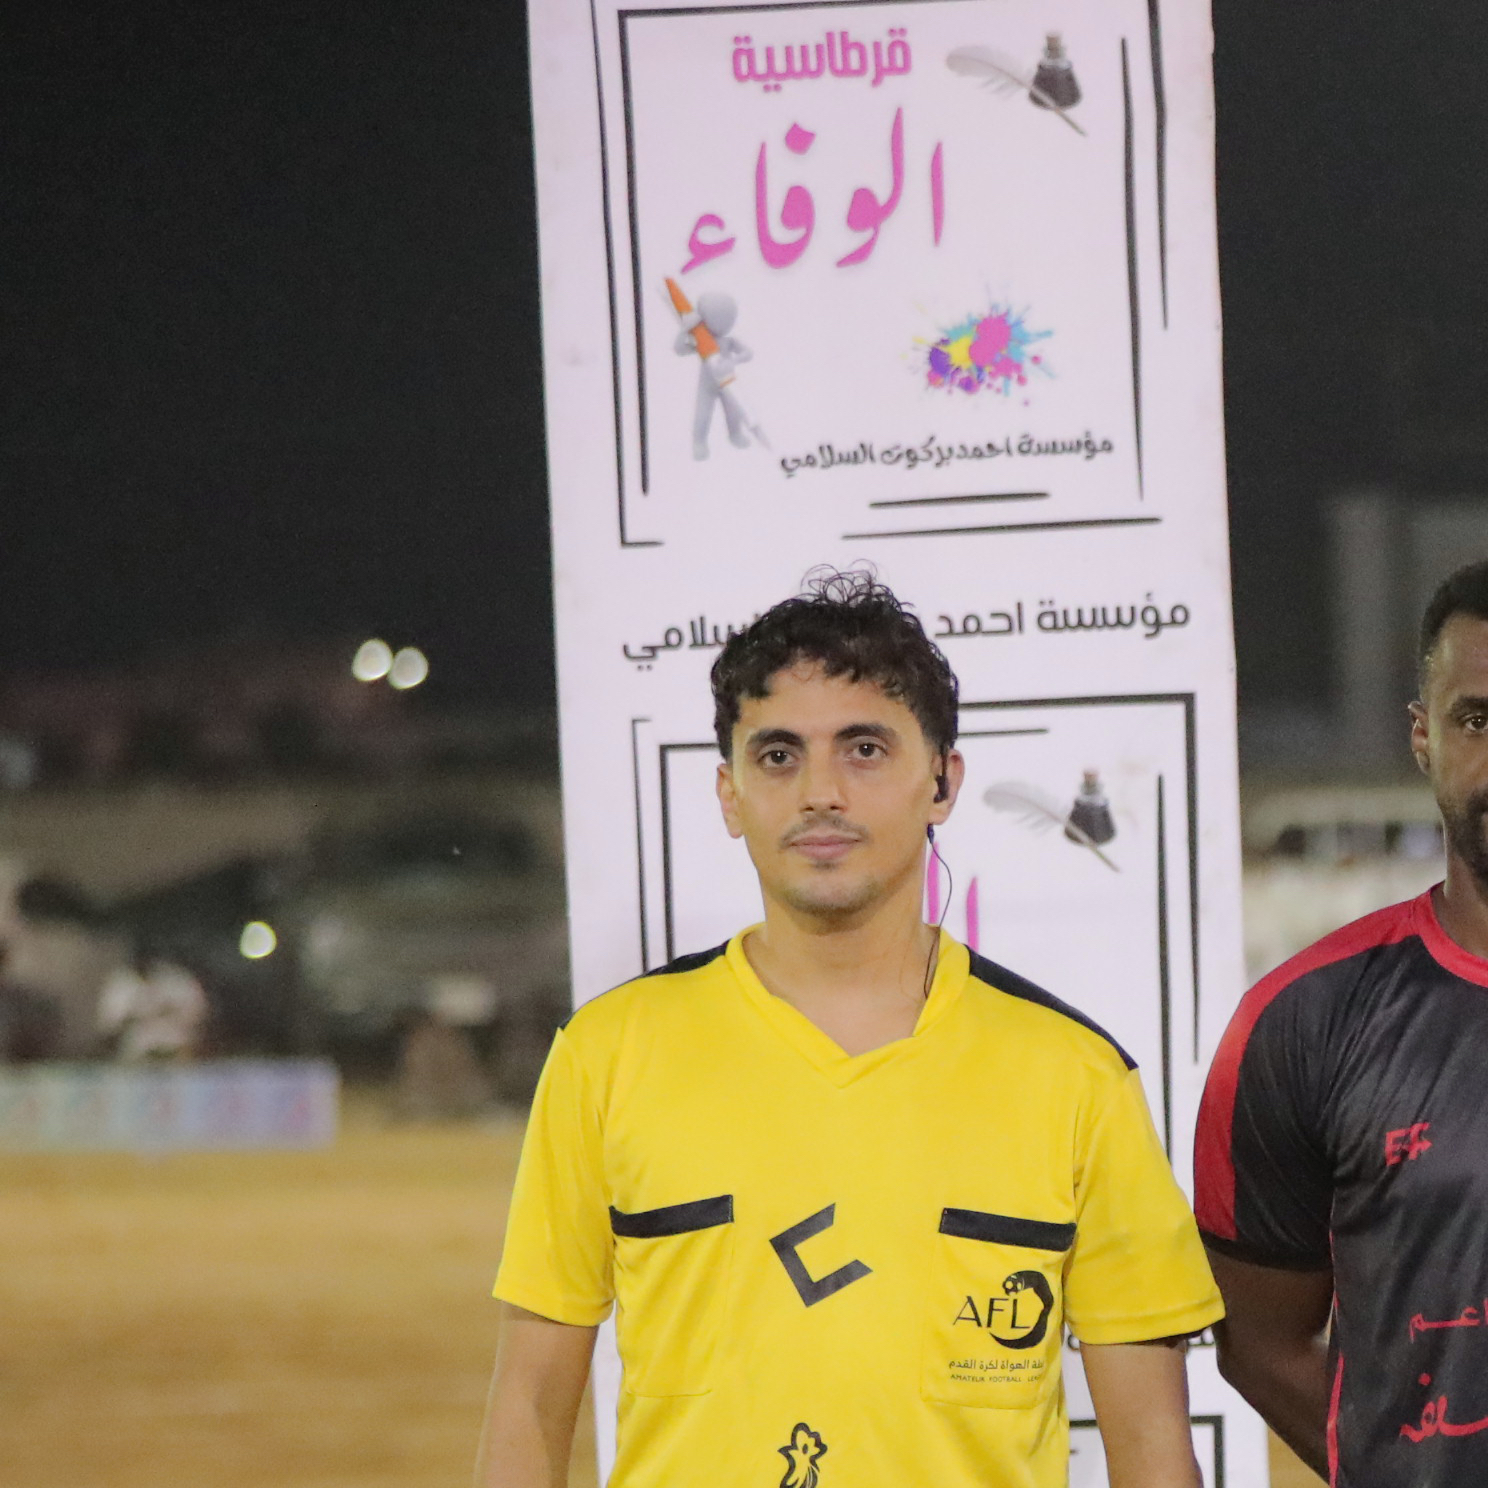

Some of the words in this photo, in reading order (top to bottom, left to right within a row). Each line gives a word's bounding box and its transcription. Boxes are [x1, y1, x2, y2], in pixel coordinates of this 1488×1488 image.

[731, 27, 912, 94] قرطاسية
[678, 106, 945, 275] الوفاء
[780, 443, 876, 478] السلامي
[1016, 430, 1115, 461] مؤسسة
[934, 601, 1025, 640] احمد
[1036, 591, 1191, 639] مؤسسة
[622, 610, 758, 672] سلامي
[952, 1295, 1031, 1330] AFL
[948, 1359, 977, 1371] القدم
[979, 1359, 999, 1373] لكرة
